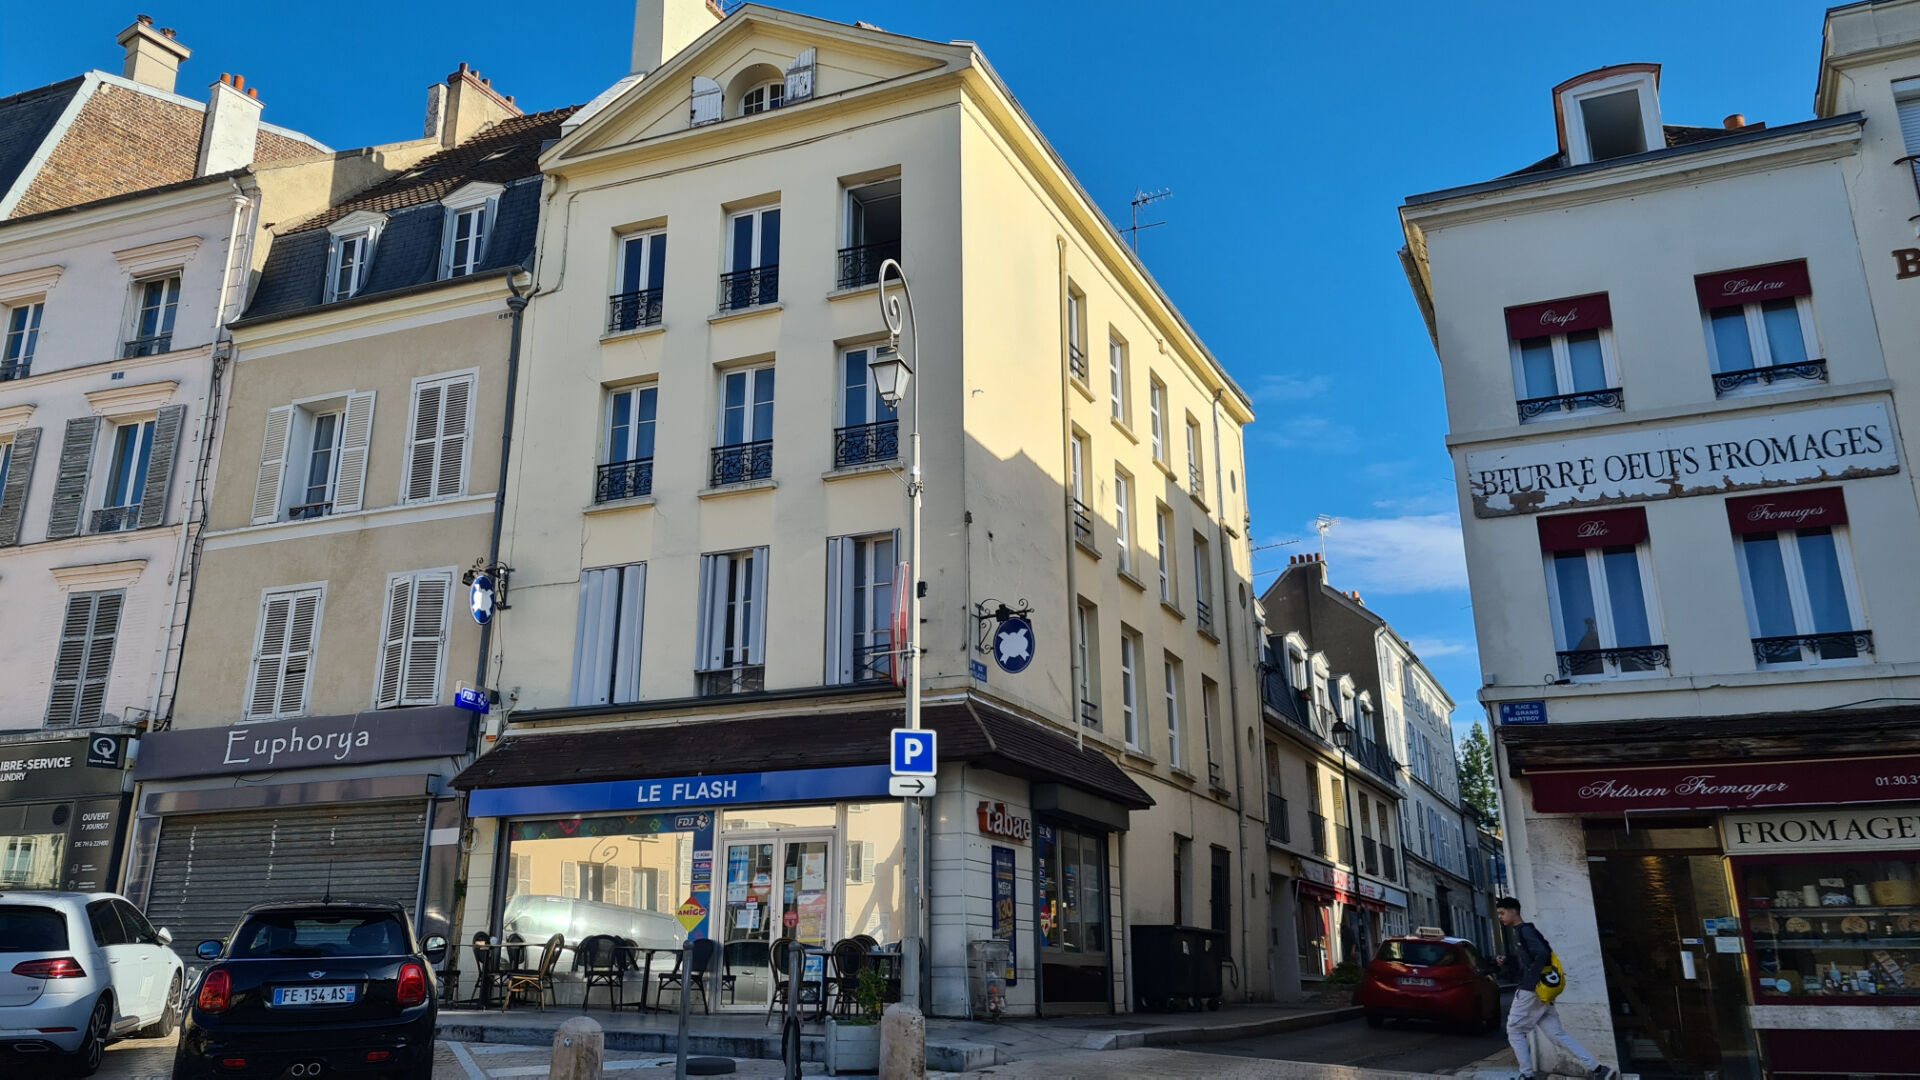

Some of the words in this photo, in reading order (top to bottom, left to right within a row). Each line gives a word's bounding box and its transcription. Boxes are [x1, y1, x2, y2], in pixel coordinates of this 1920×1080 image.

[1722, 278, 1763, 296] Lait
[1764, 281, 1785, 290] cru
[1479, 458, 1597, 497] BEURRE
[1604, 447, 1699, 482] OEUFS
[1705, 424, 1883, 472] FROMAGES
[1747, 503, 1827, 523] Fromages
[1577, 520, 1609, 538] Bio
[223, 726, 369, 764] Euphorya
[904, 738, 923, 765] P
[0, 757, 71, 771] IBRE-SERVICE
[0, 772, 26, 782] UNDRY
[637, 785, 662, 803] LE
[672, 780, 737, 801] FLASH
[1578, 779, 1670, 799] Artisan
[1675, 775, 1789, 800] Fromager
[82, 812, 110, 821] OUVERT
[677, 818, 694, 826] FDJ
[678, 906, 706, 916] AMIGO
